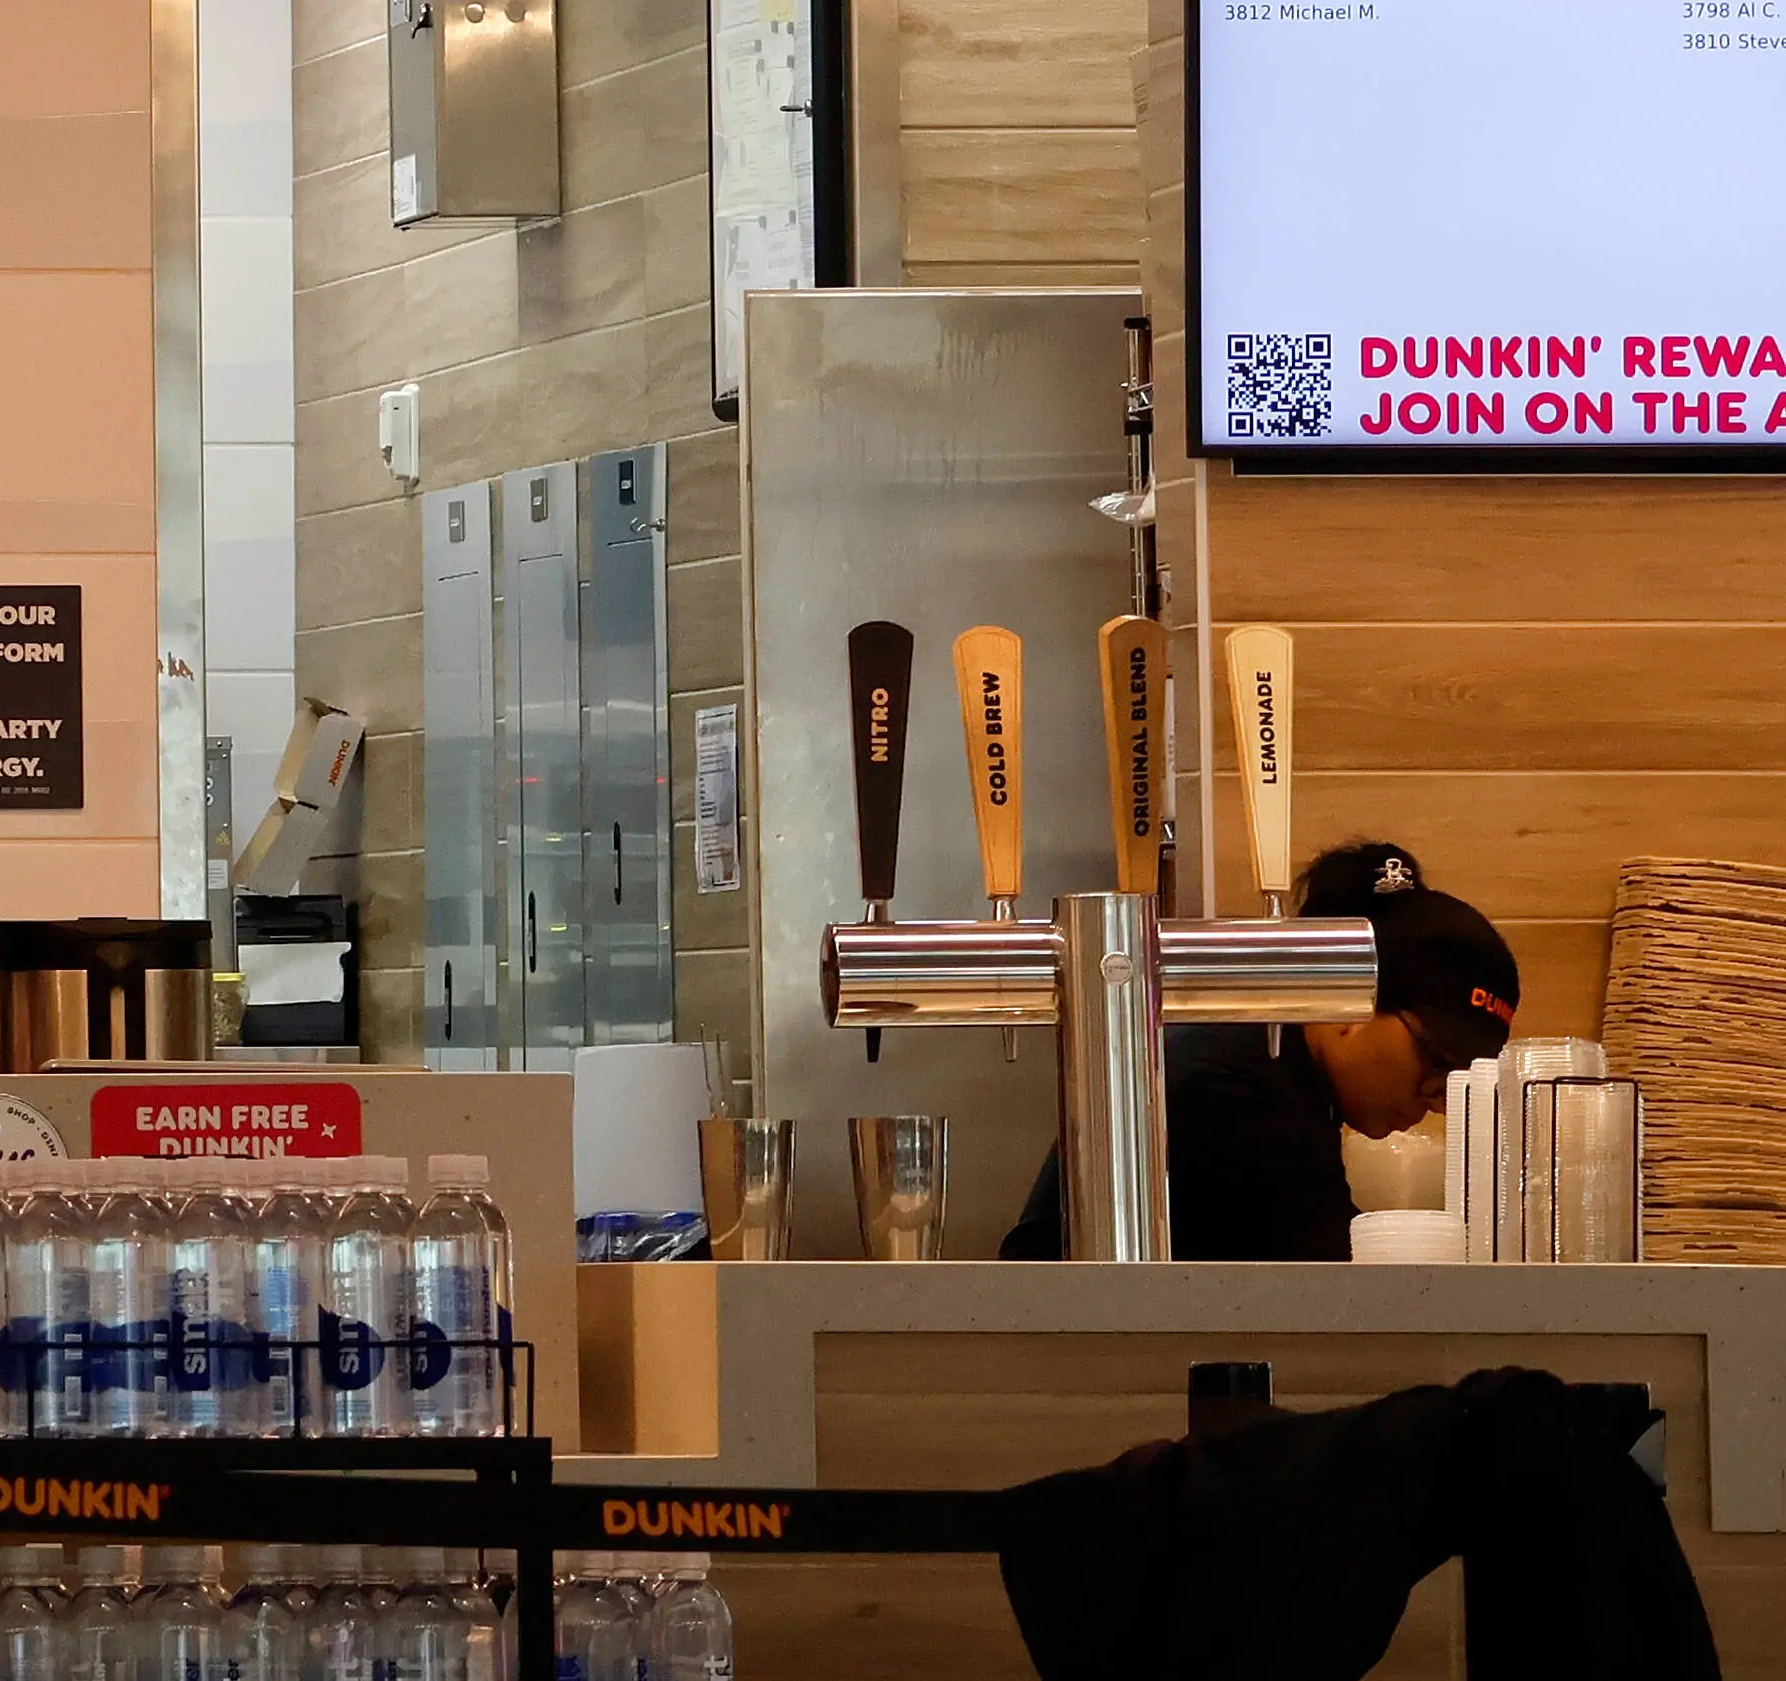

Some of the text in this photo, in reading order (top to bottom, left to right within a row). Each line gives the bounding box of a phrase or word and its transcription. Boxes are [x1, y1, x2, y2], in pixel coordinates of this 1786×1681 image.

[1226, 5, 1379, 22] 3812 Michael M.
[1684, 3, 1780, 20] 3798 Al C.
[1685, 34, 1786, 51] 3810 Steve
[1361, 336, 1603, 380] DUNKIN'
[1360, 393, 1506, 436] JOIN
[1525, 392, 1614, 436] ON
[1632, 392, 1748, 436] THE
[871, 688, 889, 762] NITRO
[981, 671, 1008, 806] COLD BREW
[1131, 645, 1149, 837] ORIGINAL BLEND
[1257, 672, 1276, 783] LEMONADE
[135, 1104, 309, 1131] EARN FREE
[602, 1499, 791, 1540] DUNKIN'
